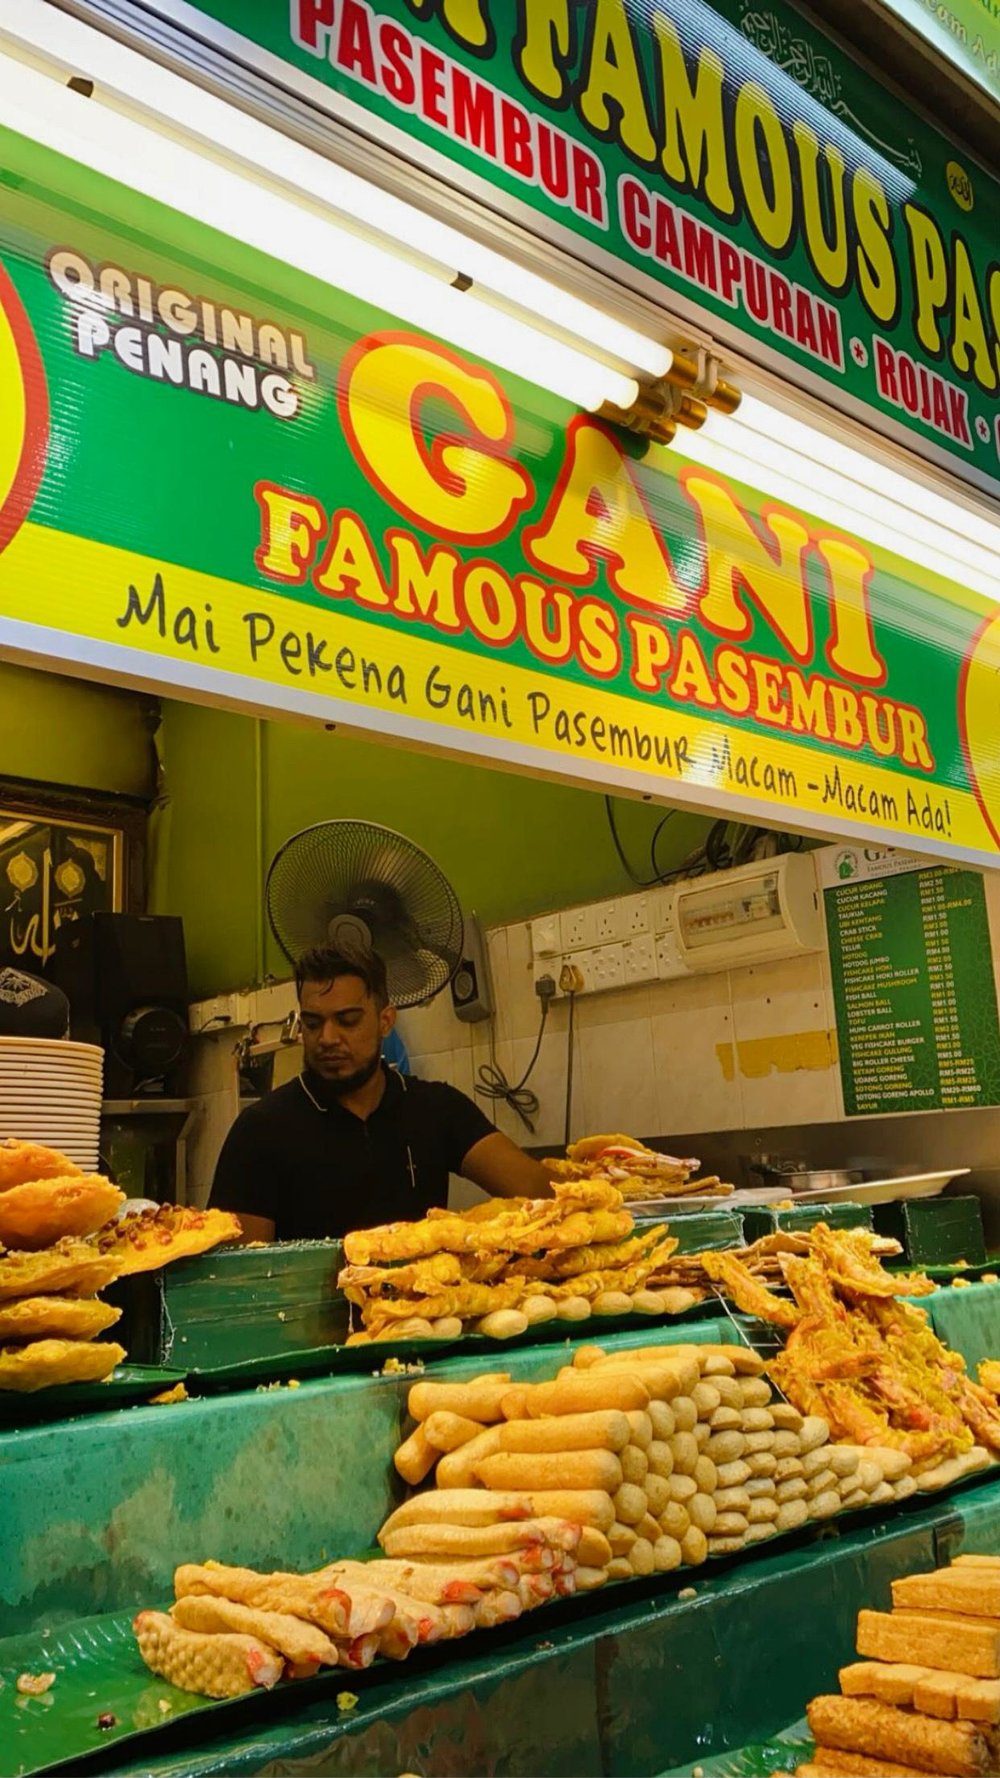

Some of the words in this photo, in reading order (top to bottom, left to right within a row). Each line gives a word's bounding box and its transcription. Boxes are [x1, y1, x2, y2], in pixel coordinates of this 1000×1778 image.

[514, 0, 901, 325] FAMOUS
[902, 198, 1000, 392] PA
[293, 0, 609, 226] PASEMBUR
[621, 176, 843, 369] CAMPURAN
[875, 335, 971, 446] ROJAK
[46, 249, 316, 381] ORIGINAL
[73, 308, 302, 420] PENANG
[340, 334, 887, 685] GANI
[257, 485, 621, 678] FAMOUS
[632, 616, 935, 772] PASEMBUR
[117, 572, 220, 653] Mai
[243, 612, 407, 704] Pekena
[425, 664, 513, 728] Gani
[709, 734, 797, 798] Macam
[907, 788, 952, 838] Ada!
[836, 887, 857, 897] CUCUR
[859, 882, 883, 892] UDANG
[837, 896, 858, 905] CUCUR
[860, 890, 887, 900] KACANG
[838, 903, 859, 912] CUCUR
[861, 898, 884, 908] KELAPA
[840, 928, 858, 936] CRAB
[859, 925, 876, 933] STICK
[841, 935, 864, 944] CHEESE
[865, 932, 882, 940] CRAB
[841, 943, 860, 952] TELUR
[842, 951, 867, 961] HOTDOG
[843, 959, 868, 969] HOTDOG
[870, 956, 889, 964] JUMBO
[844, 967, 874, 977] FISHCAKE
[875, 964, 892, 972] HOKI
[844, 975, 875, 985] FISHCAKE
[876, 972, 893, 980] HOKI
[894, 968, 919, 977] ROLLER
[845, 983, 875, 993] FISHCAKE
[877, 977, 917, 988] MUSHROOM
[847, 1000, 874, 1009] SALMON
[848, 1009, 875, 1018] LOBSTER
[877, 1006, 892, 1014] BALL
[868, 1023, 894, 1032] CARROT
[896, 1020, 920, 1028] ROLLER
[865, 1040, 895, 1049] FISHCAKE
[898, 1037, 924, 1045] BURGER
[852, 1050, 882, 1058] FISHCAKE
[865, 1057, 888, 1065] ROLLER
[890, 1055, 914, 1063] CHEESE
[877, 1065, 904, 1073] GORENG
[880, 1073, 907, 1081] GORENG
[855, 1084, 882, 1092] SOTONG
[884, 1082, 912, 1090] GORENG
